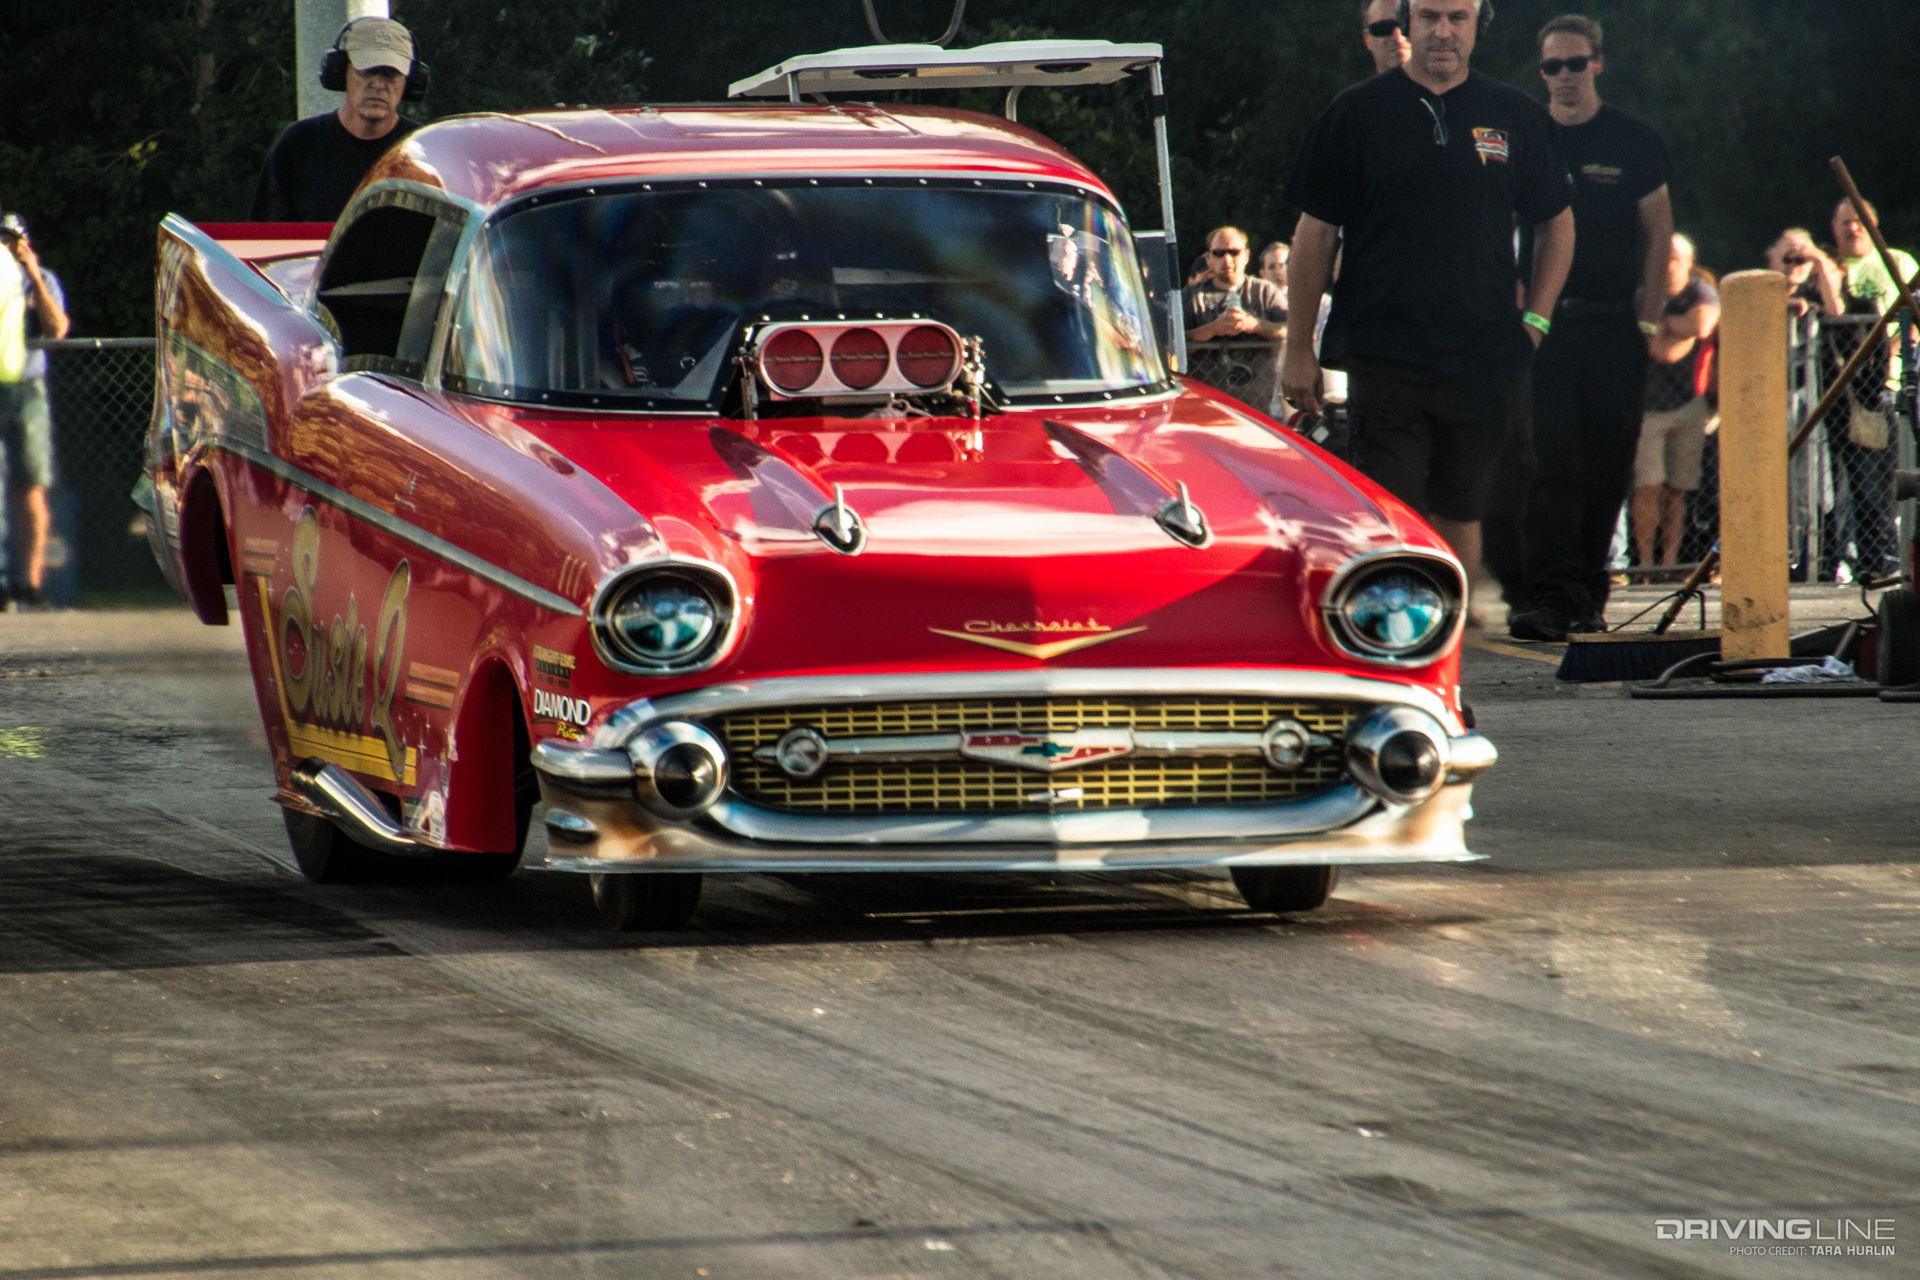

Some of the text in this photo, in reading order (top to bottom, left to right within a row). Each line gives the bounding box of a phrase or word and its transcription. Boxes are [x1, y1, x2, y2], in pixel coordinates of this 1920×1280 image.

[280, 504, 411, 784] Susie Q
[964, 617, 1112, 633] Chevrolet
[534, 688, 592, 726] DIAMOND
